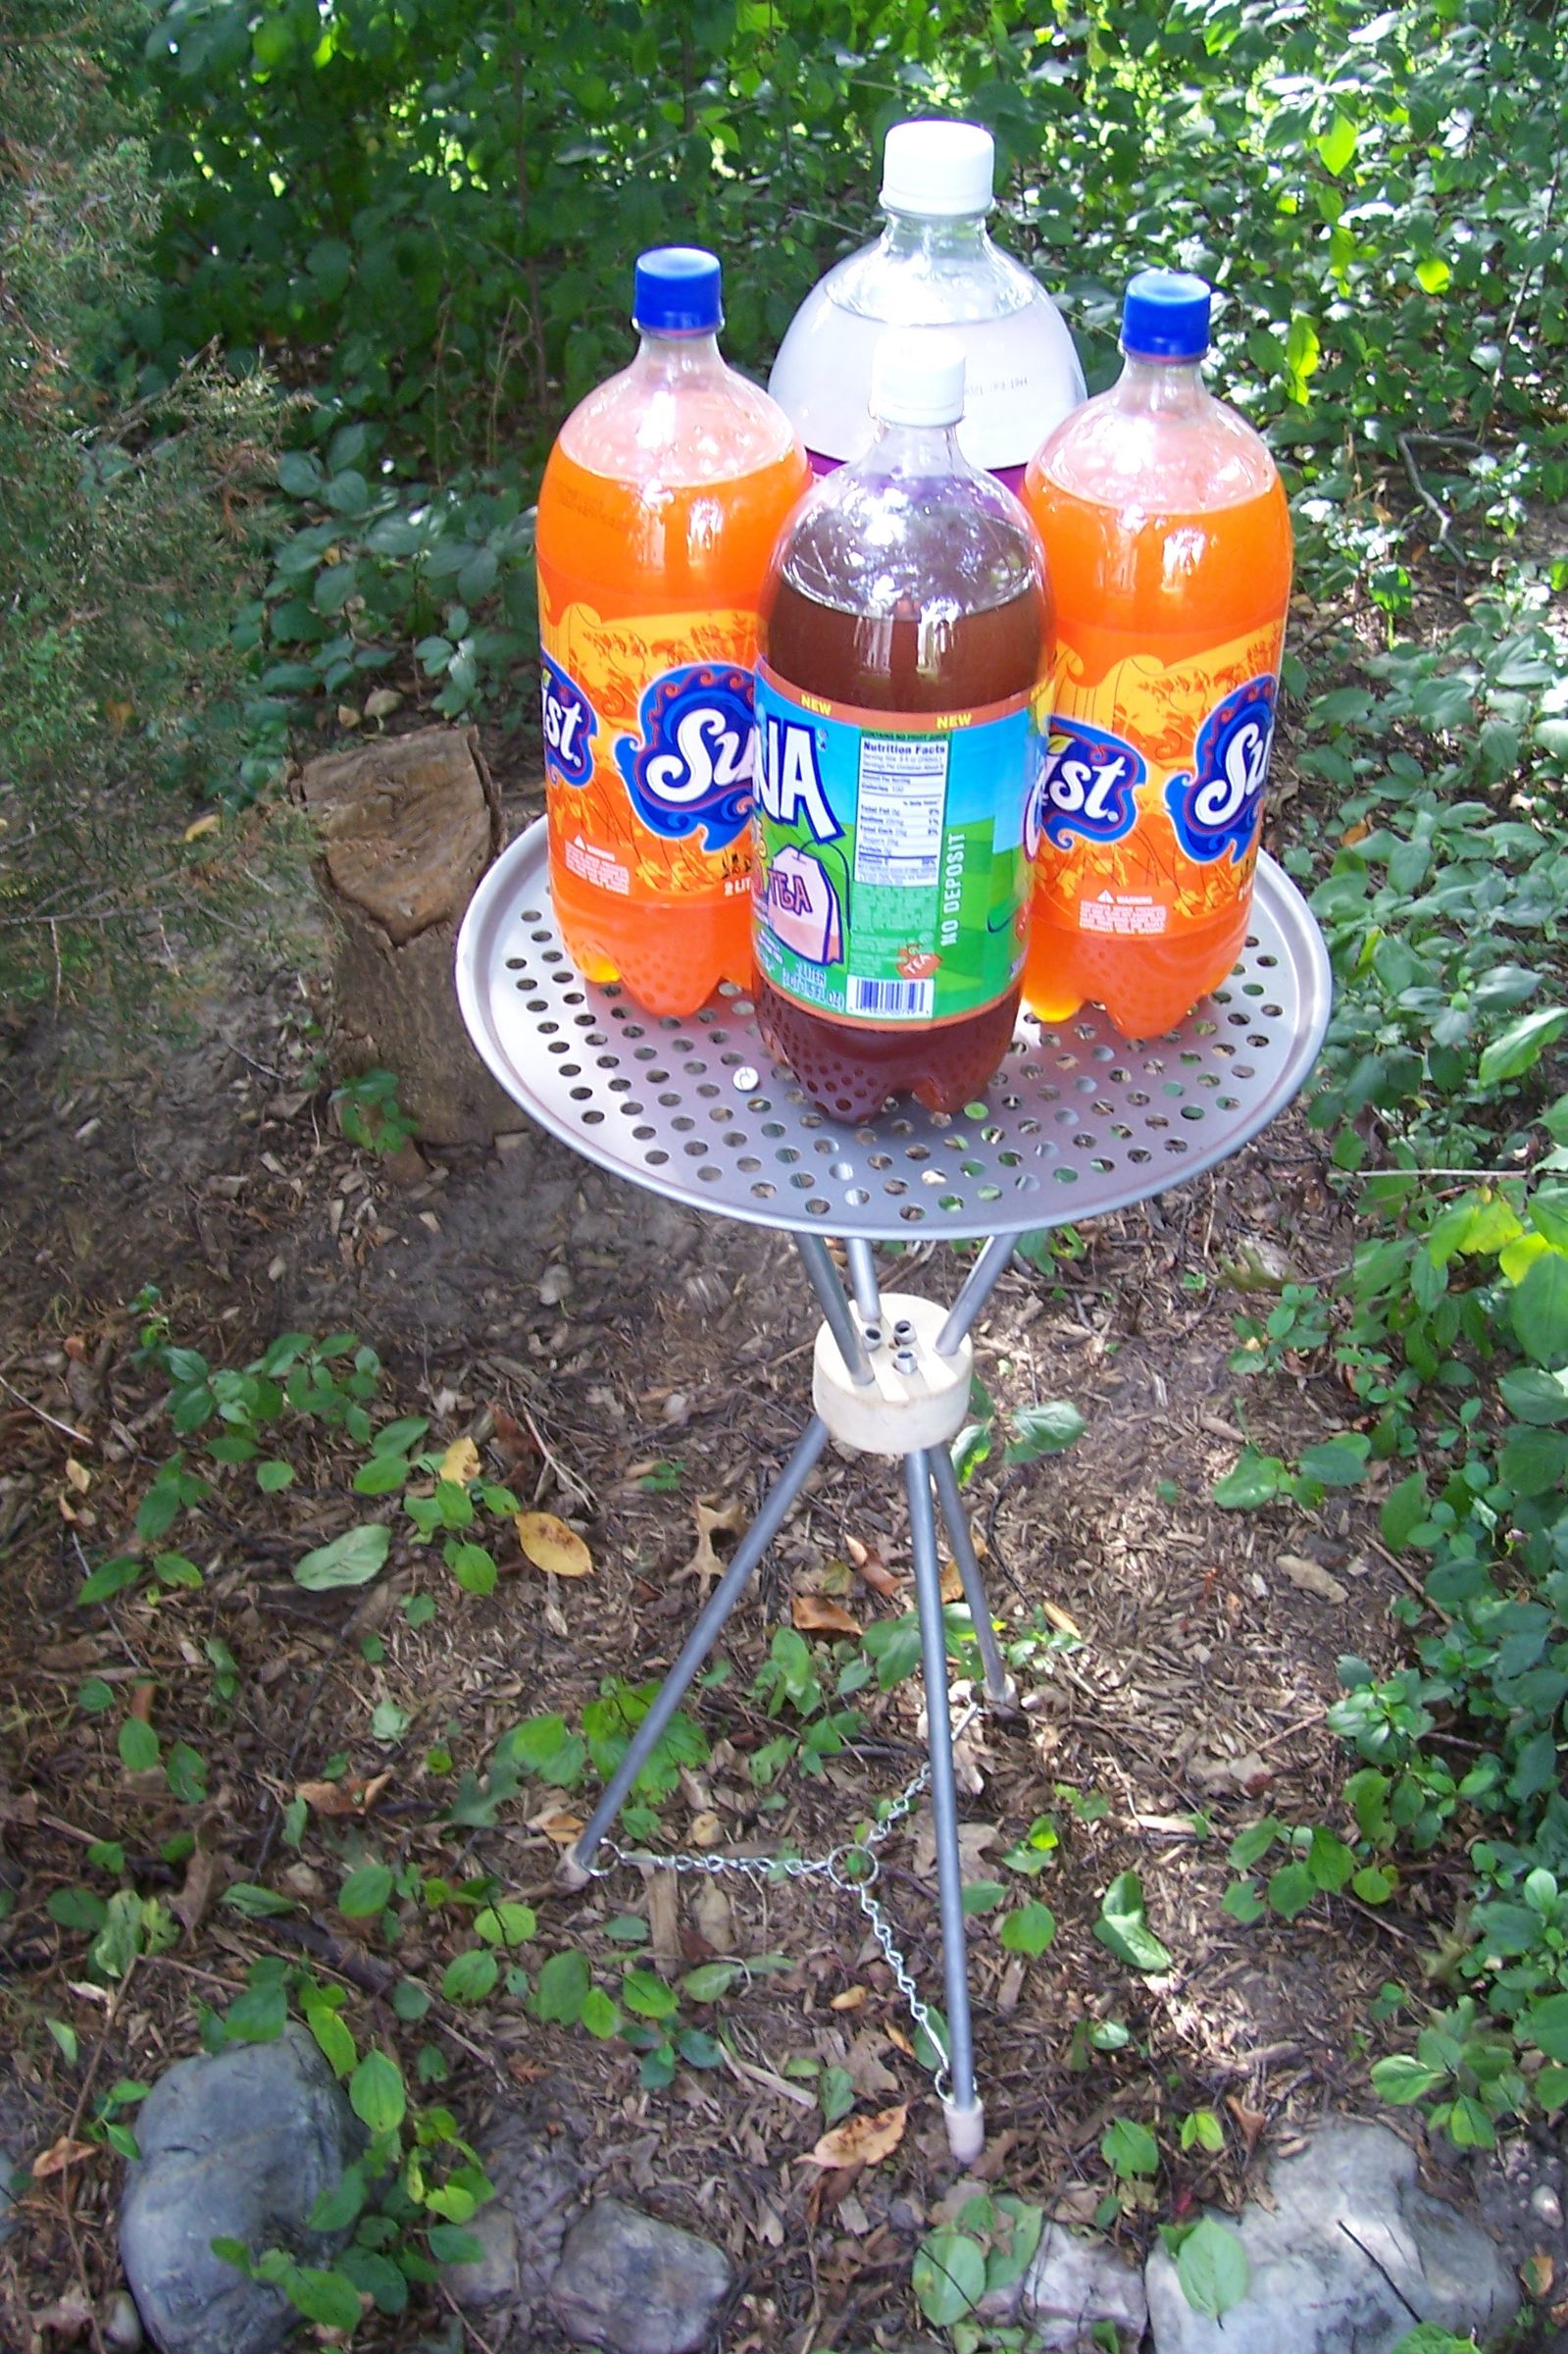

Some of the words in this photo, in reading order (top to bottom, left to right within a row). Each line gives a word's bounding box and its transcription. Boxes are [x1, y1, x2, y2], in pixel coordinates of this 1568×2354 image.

[801, 694, 832, 716] NEW
[936, 713, 973, 730] NEW
[864, 742, 912, 755] Nutrition
[916, 744, 945, 756] Facts
[943, 834, 966, 914] DEPOSIT
[768, 868, 813, 915] TEA
[940, 919, 958, 947] NO
[904, 953, 932, 974] TEA
